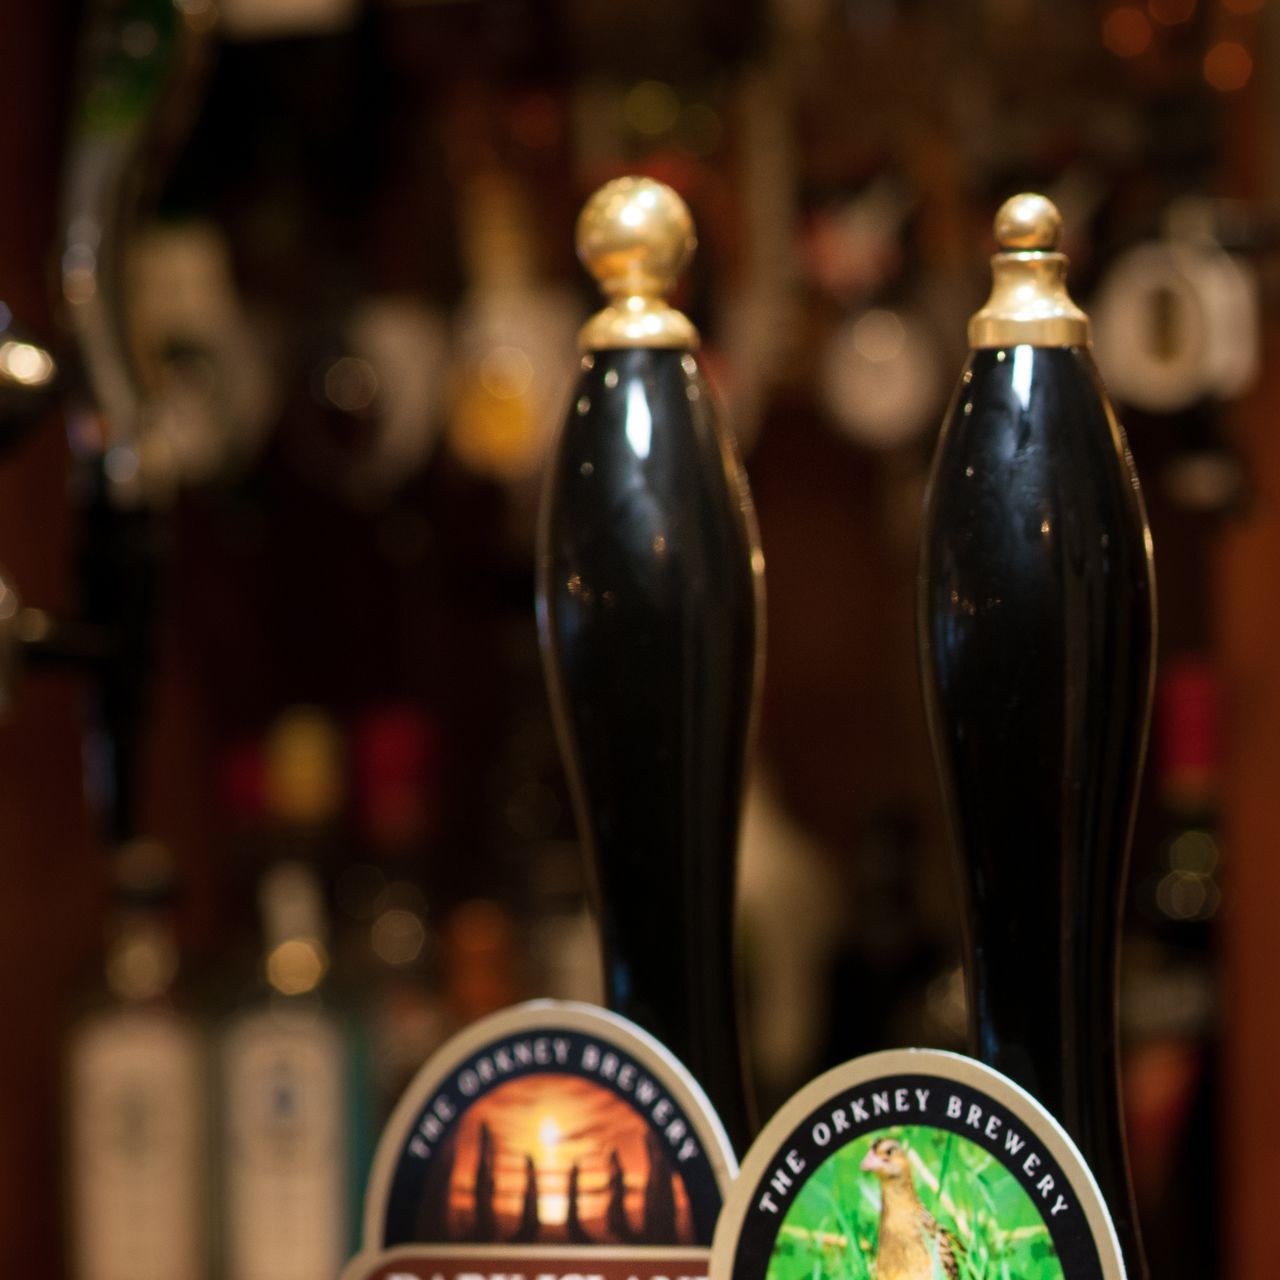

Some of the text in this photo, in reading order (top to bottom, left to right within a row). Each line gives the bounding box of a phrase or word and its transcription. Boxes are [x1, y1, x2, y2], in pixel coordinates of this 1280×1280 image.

[409, 1038, 700, 1164] THE ORKNEY BREWERY
[759, 1088, 1070, 1217] THE ORKNEY BREWERY
